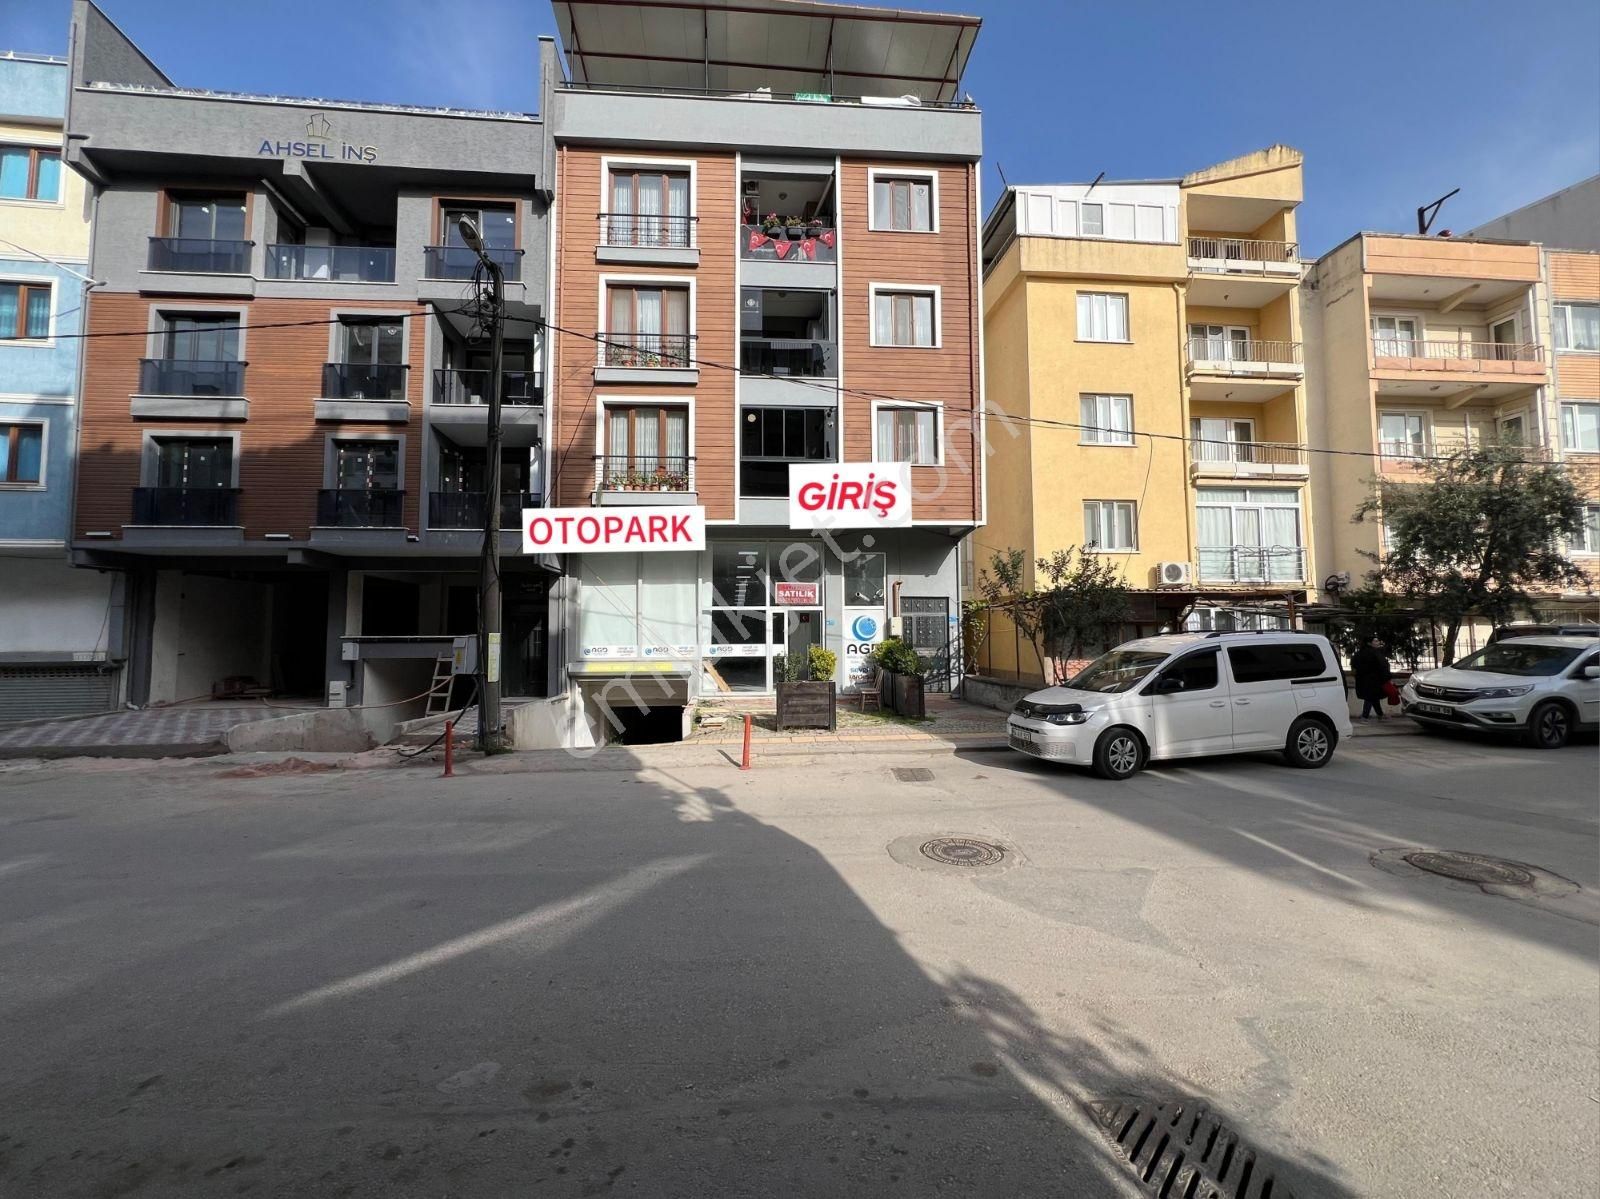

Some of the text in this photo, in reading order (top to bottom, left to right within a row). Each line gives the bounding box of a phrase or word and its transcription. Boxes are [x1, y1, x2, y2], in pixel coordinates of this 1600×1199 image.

[258, 140, 377, 163] AHSEL İNŞ
[778, 590, 815, 598] SATILIK
